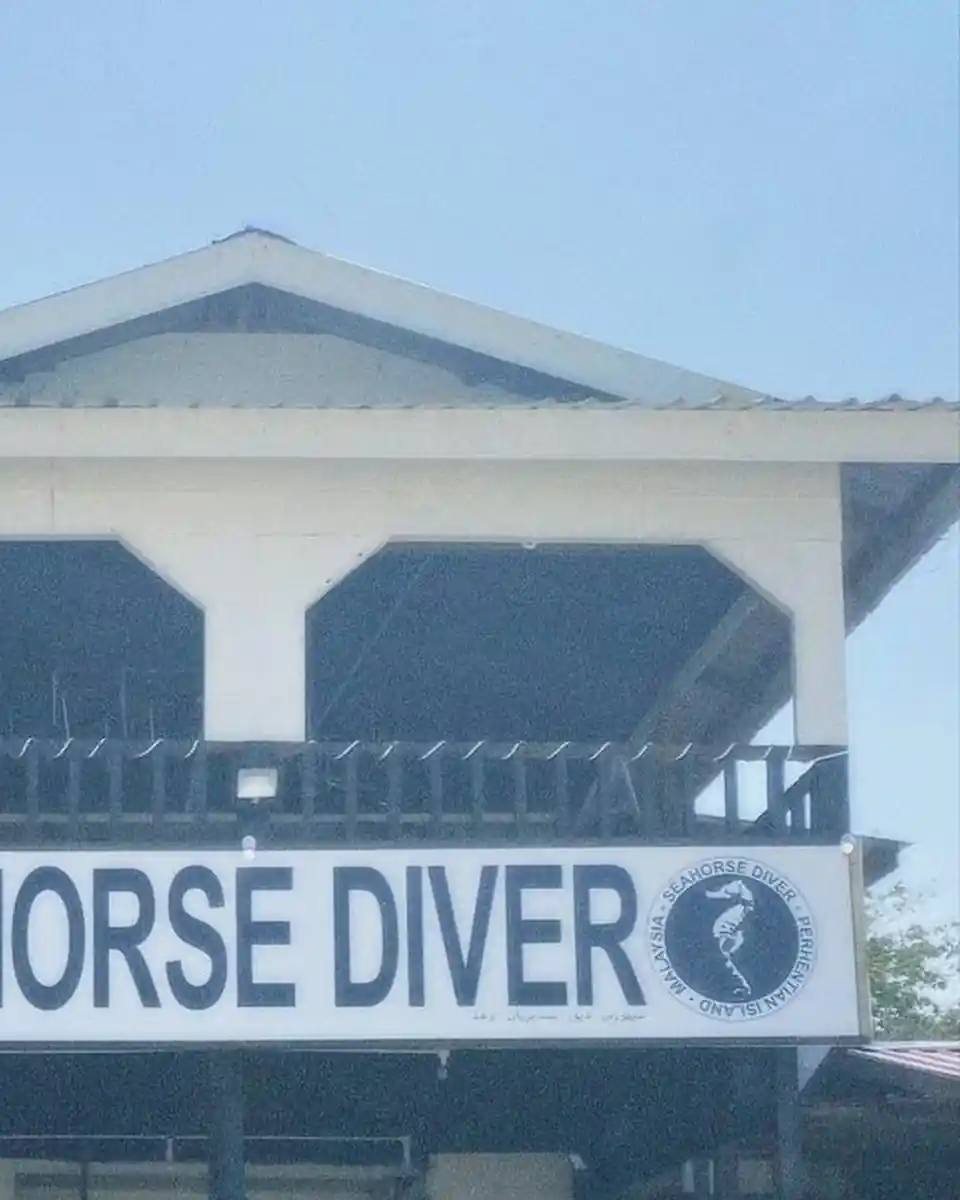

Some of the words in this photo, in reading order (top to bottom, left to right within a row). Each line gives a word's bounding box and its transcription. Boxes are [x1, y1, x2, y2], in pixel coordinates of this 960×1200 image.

[661, 860, 747, 903] SEAHORSE
[751, 864, 797, 904] DIVER
[332, 864, 647, 1007] DIVER
[648, 915, 688, 996] MALAYSIA
[762, 915, 814, 1009] PERHENTIAN
[699, 998, 761, 1017] ISLAND
